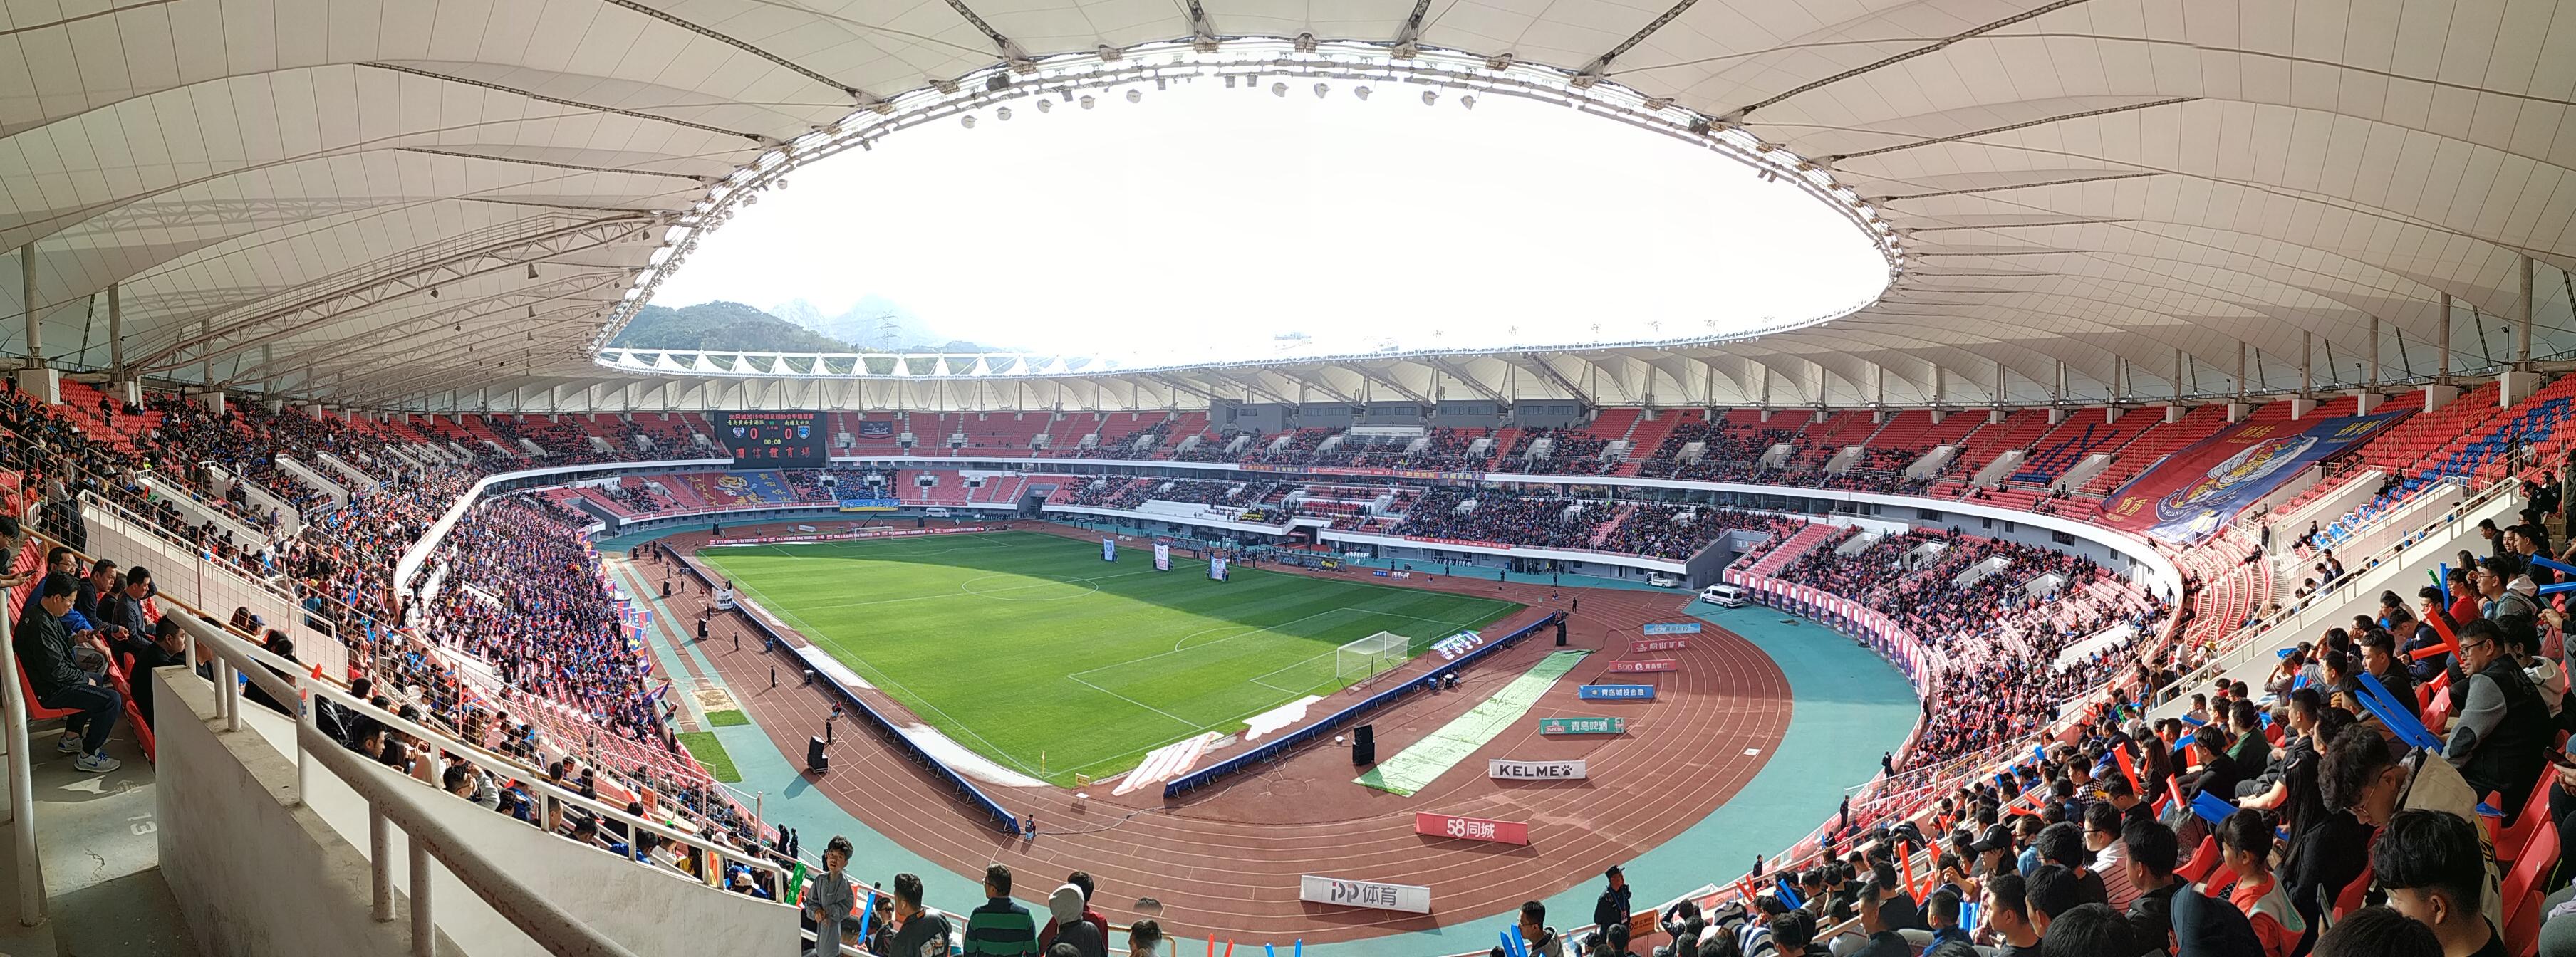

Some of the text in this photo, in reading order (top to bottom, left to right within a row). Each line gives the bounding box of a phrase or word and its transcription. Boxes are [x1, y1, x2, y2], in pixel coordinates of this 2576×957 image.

[749, 427, 759, 440] 0
[784, 427, 793, 440] 0
[1500, 764, 1559, 777] KELME
[128, 812, 157, 835] 13
[1446, 818, 1495, 839] 58同城
